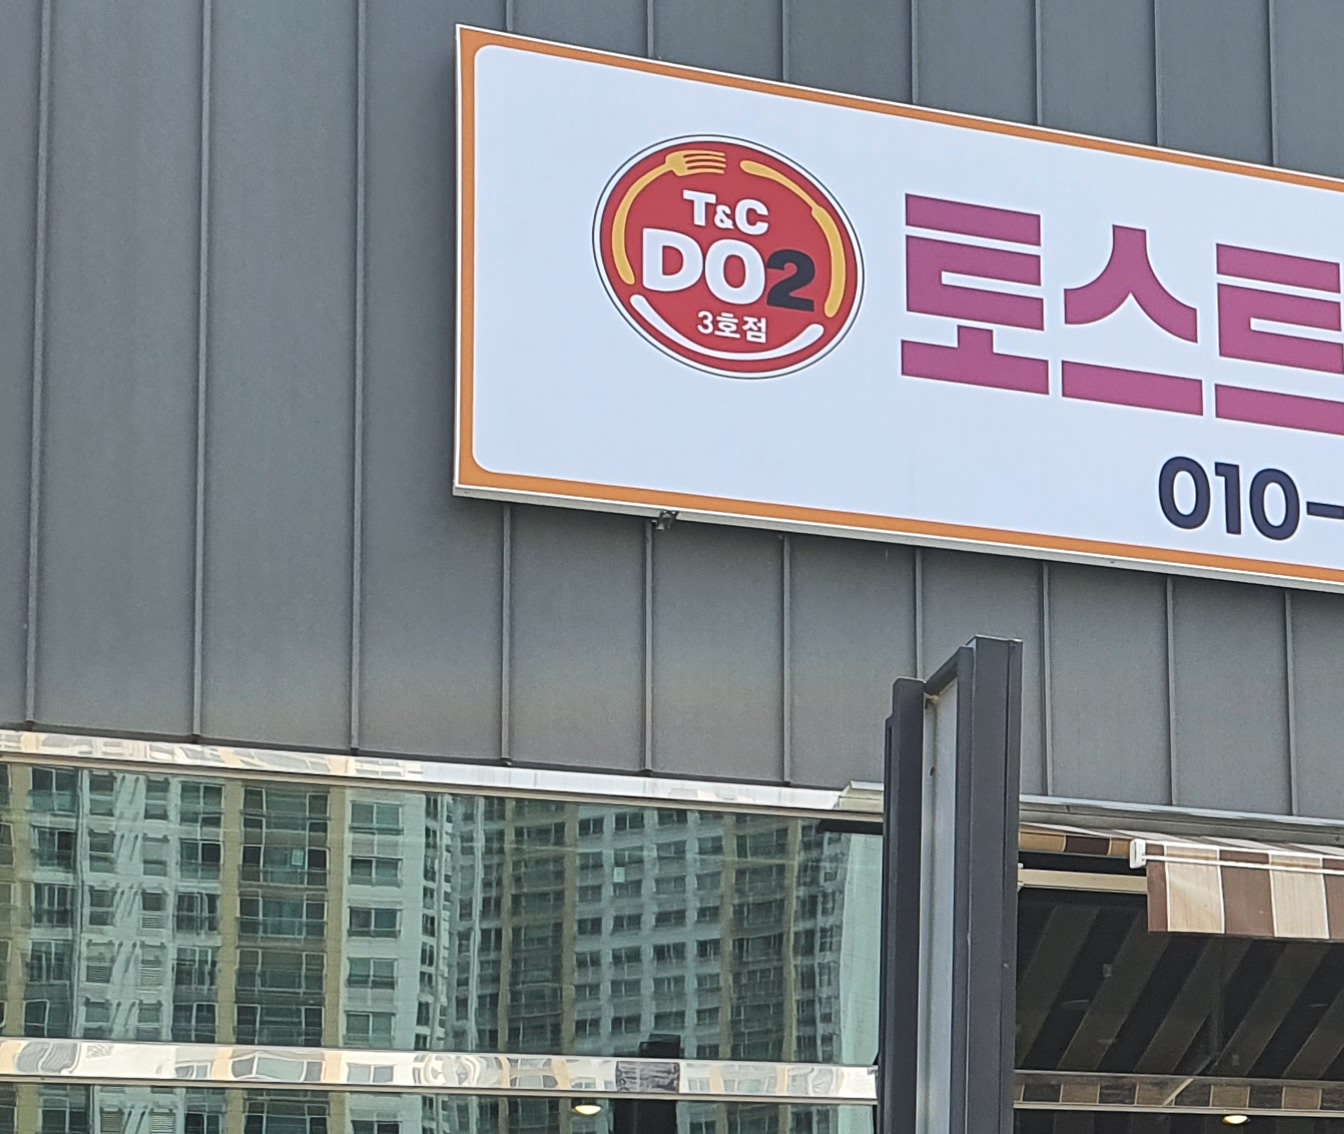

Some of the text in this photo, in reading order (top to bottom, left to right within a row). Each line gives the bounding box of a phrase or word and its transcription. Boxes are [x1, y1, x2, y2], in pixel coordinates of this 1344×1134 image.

[682, 189, 769, 236] T&C
[642, 227, 816, 313] DO2
[697, 310, 767, 343] 3호점
